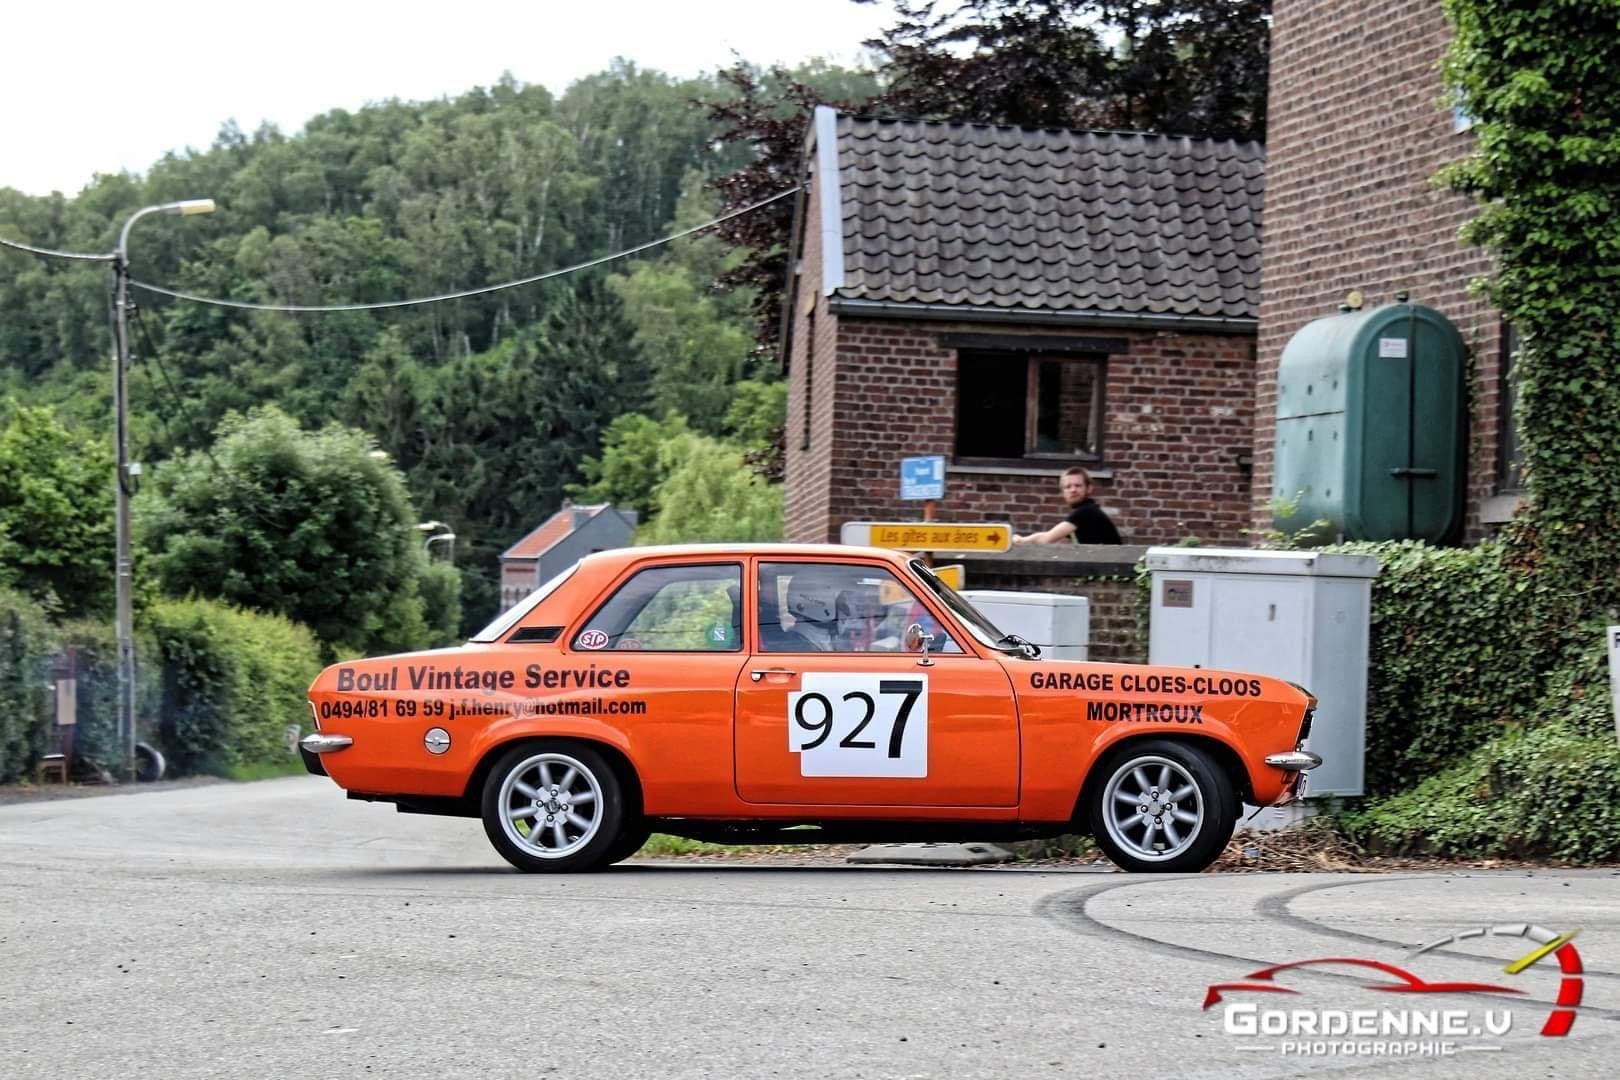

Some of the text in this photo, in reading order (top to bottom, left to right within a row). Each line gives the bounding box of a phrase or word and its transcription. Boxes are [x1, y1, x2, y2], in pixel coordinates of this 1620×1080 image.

[880, 527, 899, 543] Les
[931, 531, 951, 543] aux
[582, 632, 605, 646] STP
[337, 663, 631, 696] Boul Vintage Service
[1030, 672, 1262, 698] GARAGE CLOES-CLOOS
[320, 696, 647, 720] 0494/81 69 59 j.f.henry@hotmail.com
[794, 680, 924, 760] 927
[1086, 701, 1204, 725] MORTROUX
